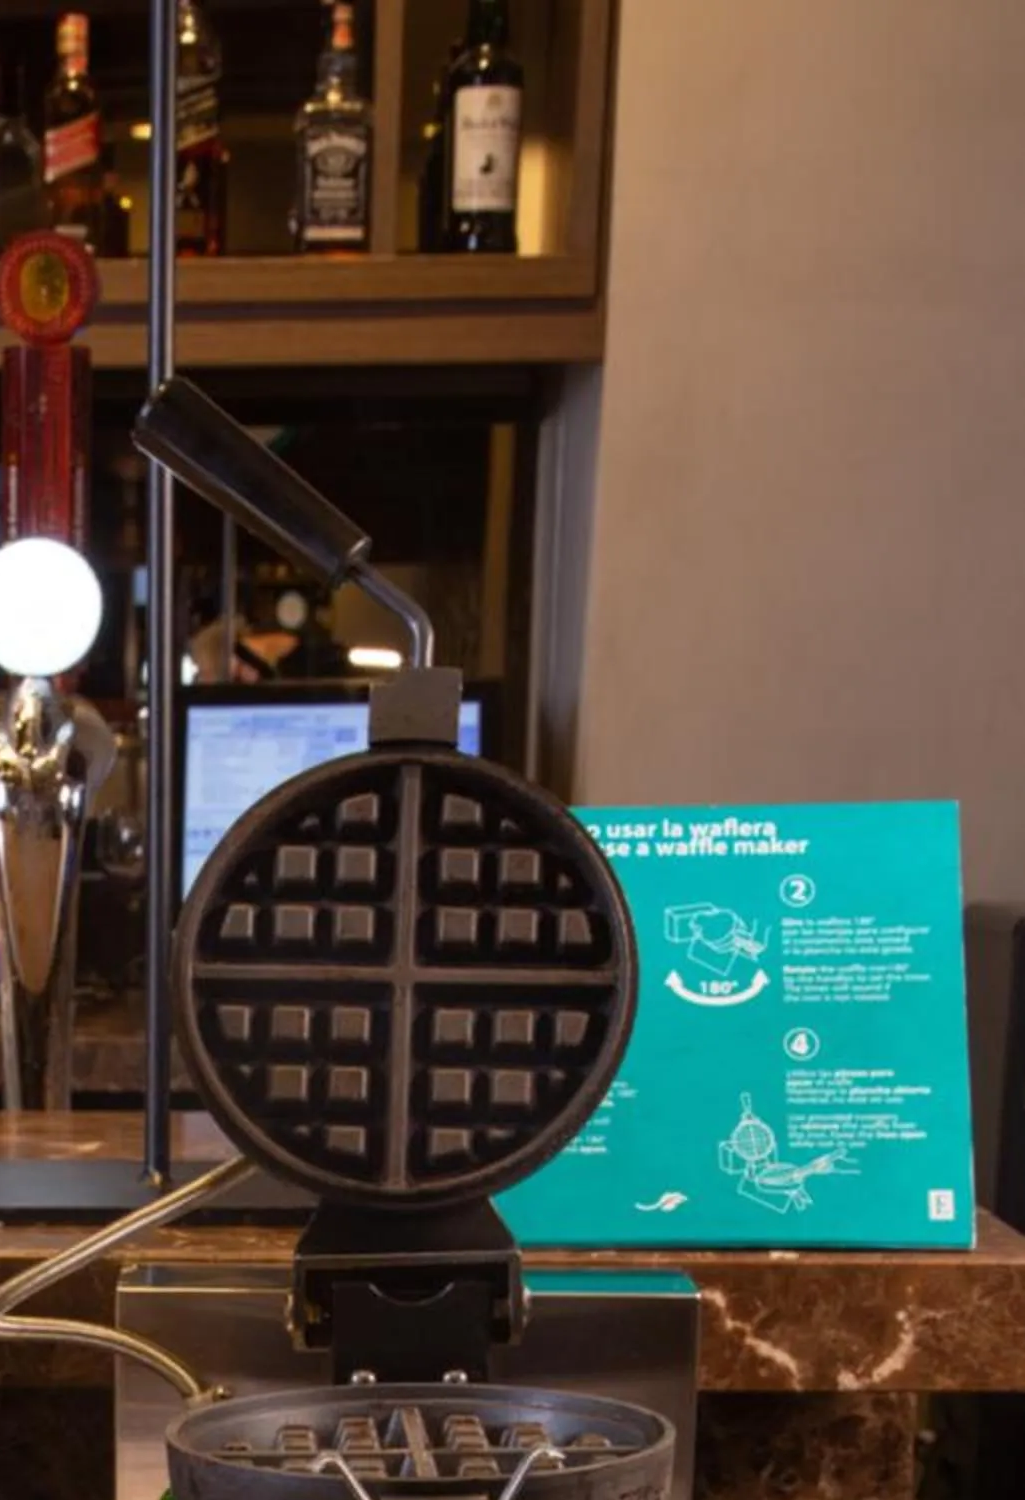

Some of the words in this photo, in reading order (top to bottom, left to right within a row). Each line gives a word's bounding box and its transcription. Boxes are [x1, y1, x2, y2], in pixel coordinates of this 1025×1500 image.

[606, 824, 657, 839] usar
[663, 819, 683, 838] la
[601, 841, 631, 857] se
[636, 841, 650, 857] a
[656, 835, 727, 857] waffle
[734, 837, 809, 855] maker
[790, 880, 807, 901] 2
[791, 1032, 810, 1054] 4
